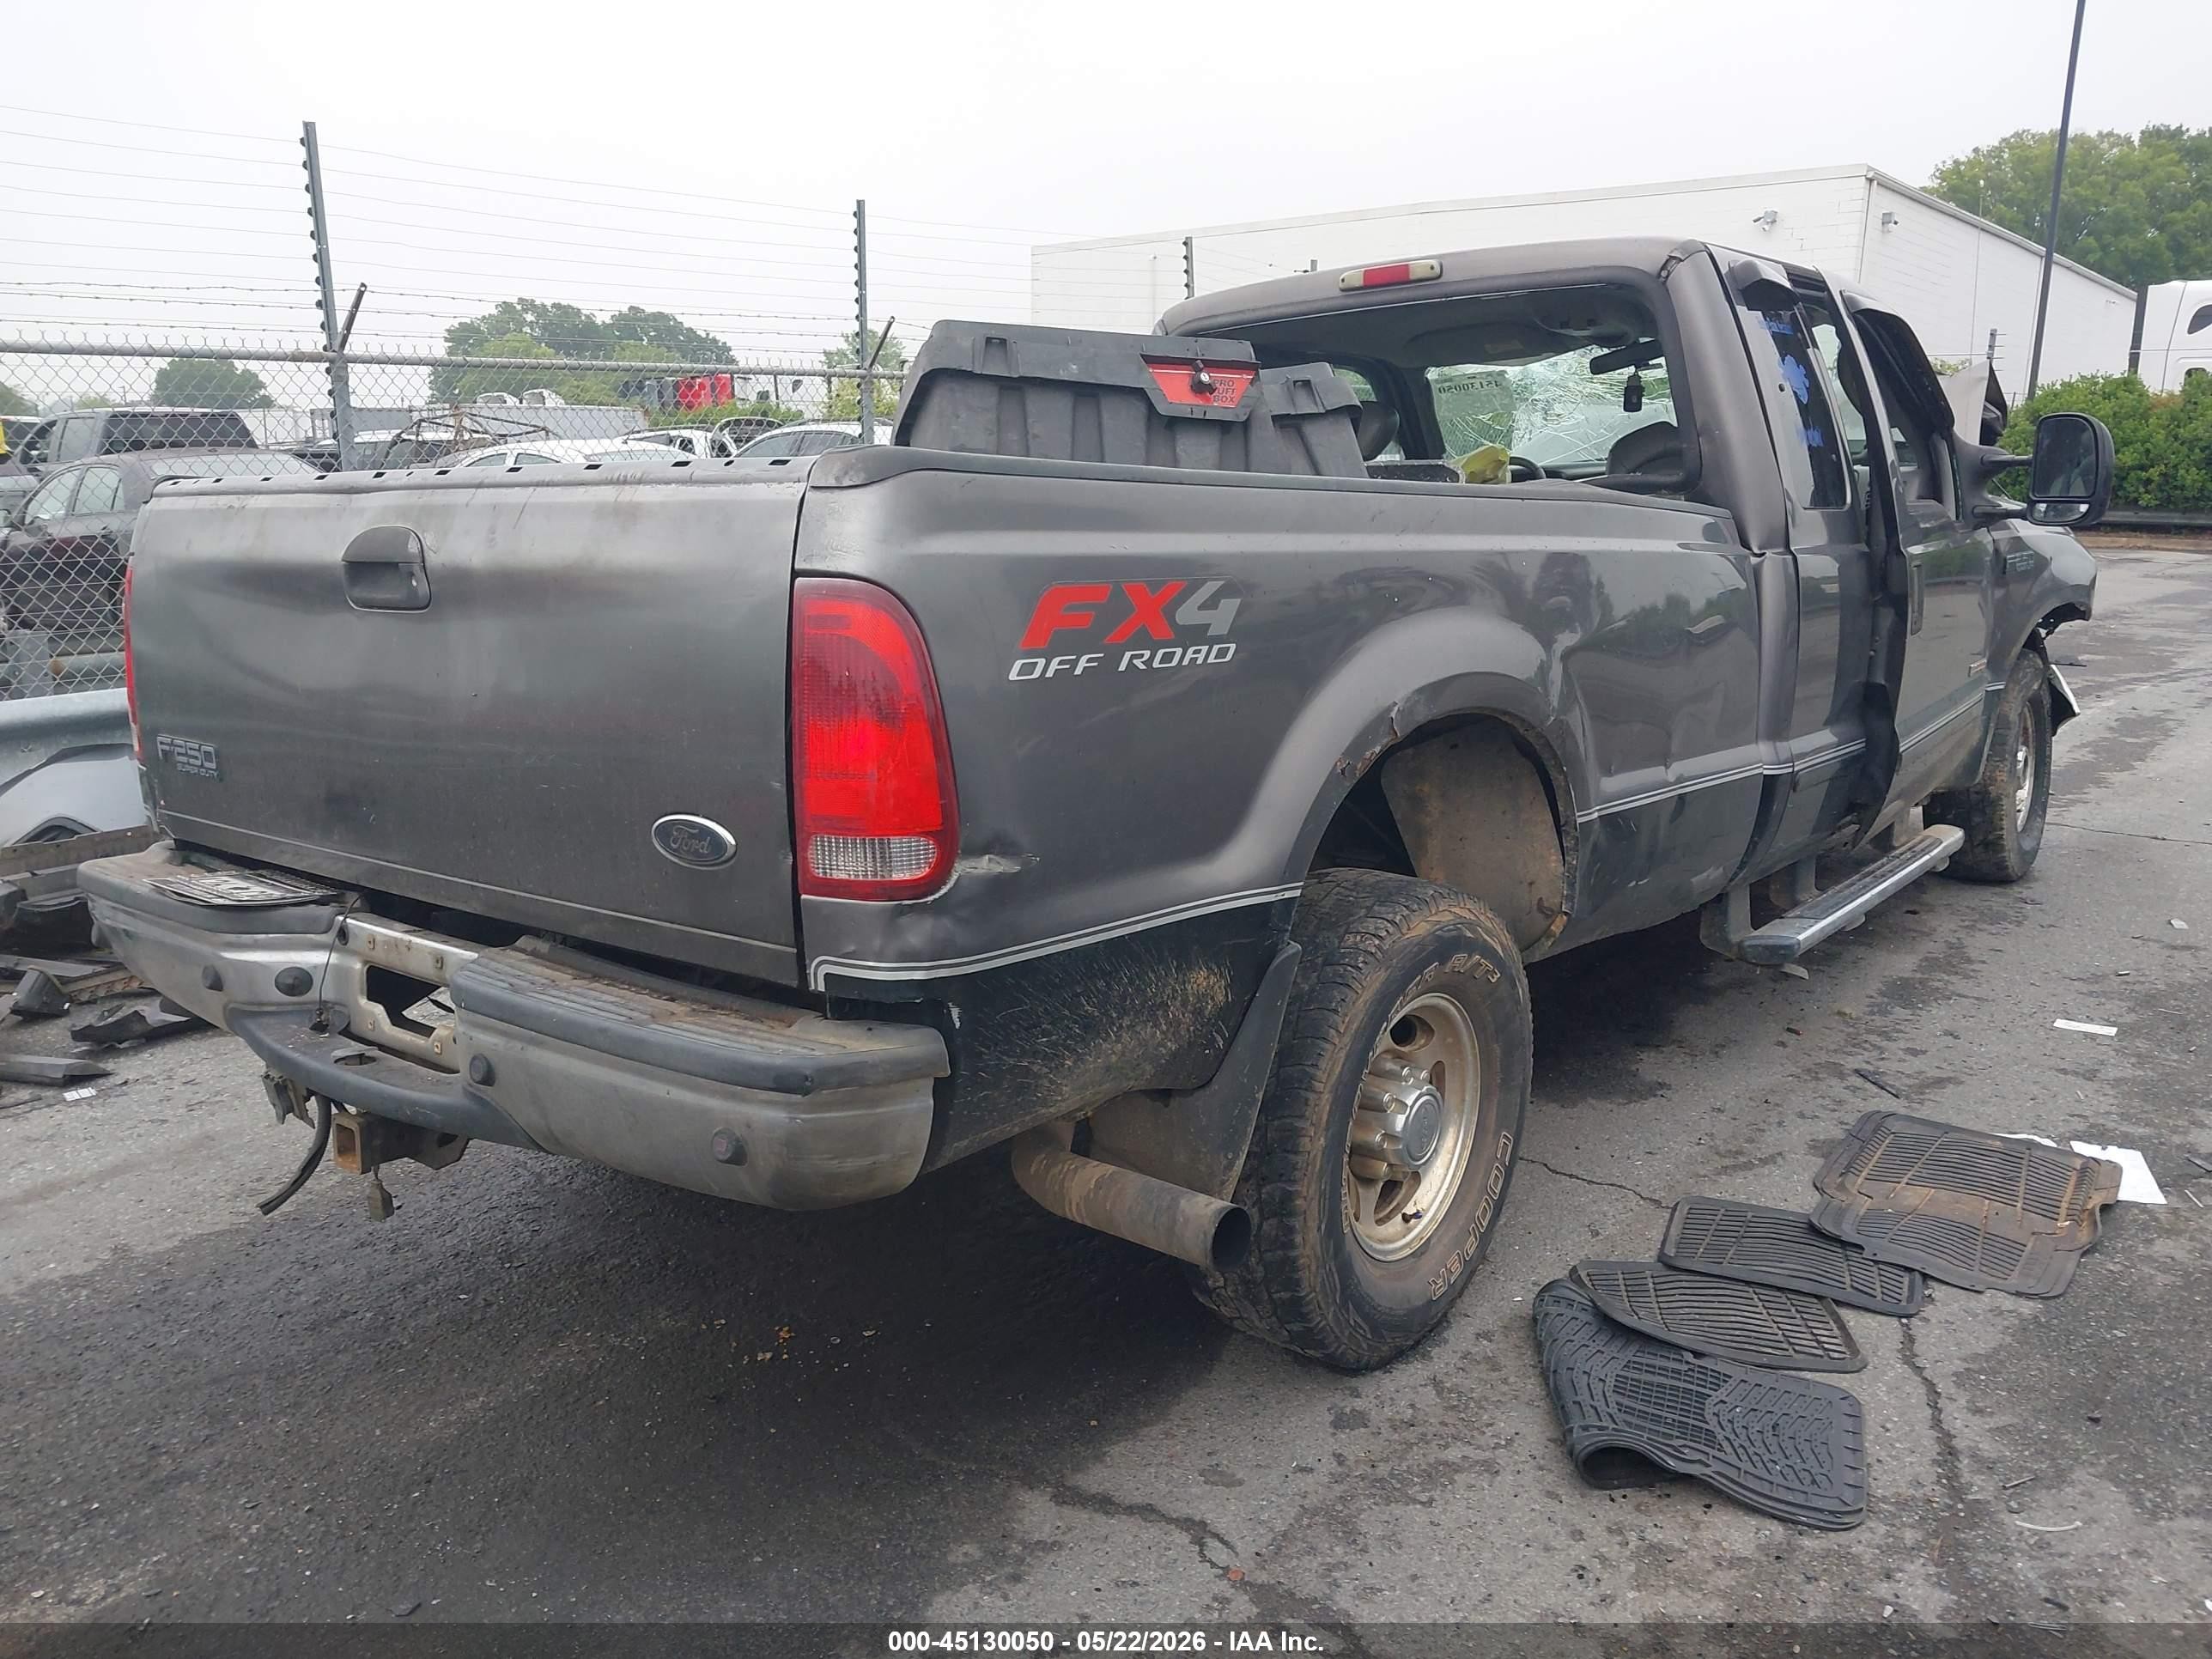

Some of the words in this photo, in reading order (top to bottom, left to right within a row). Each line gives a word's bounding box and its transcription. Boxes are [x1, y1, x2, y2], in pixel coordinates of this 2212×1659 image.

[1212, 379, 1235, 387] PRO
[1212, 395, 1236, 404] BOX
[1018, 580, 1242, 650] FX4
[1008, 653, 1105, 680] OFF
[1117, 643, 1237, 672] ROAD
[670, 824, 712, 854] Ford
[1428, 1131, 1513, 1301] COOPER
